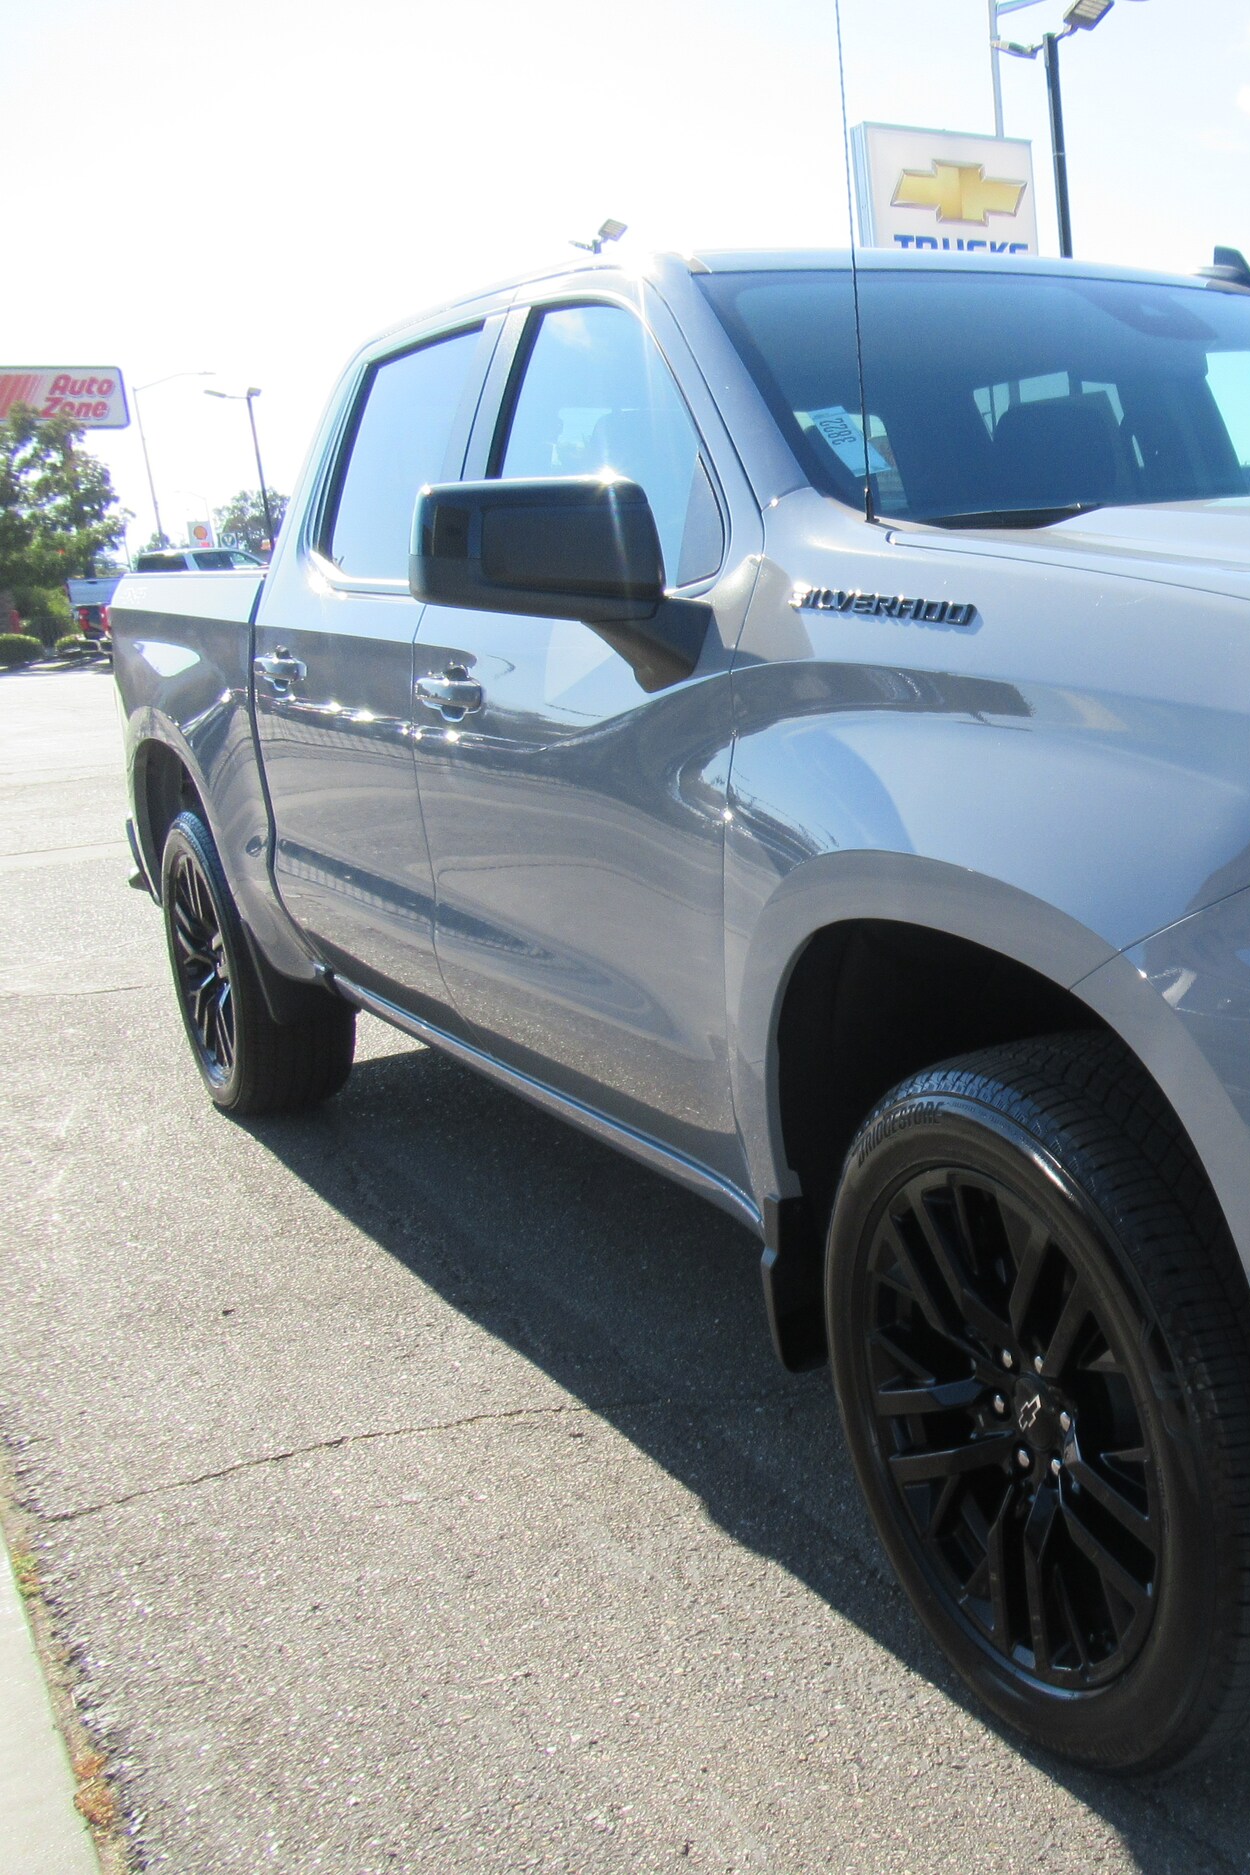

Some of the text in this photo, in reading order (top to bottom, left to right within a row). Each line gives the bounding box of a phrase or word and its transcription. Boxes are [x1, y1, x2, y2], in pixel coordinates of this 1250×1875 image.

[48, 374, 115, 396] Auto
[41, 397, 109, 419] Zone
[819, 417, 857, 446] 3822
[788, 581, 976, 627] SILVERADO
